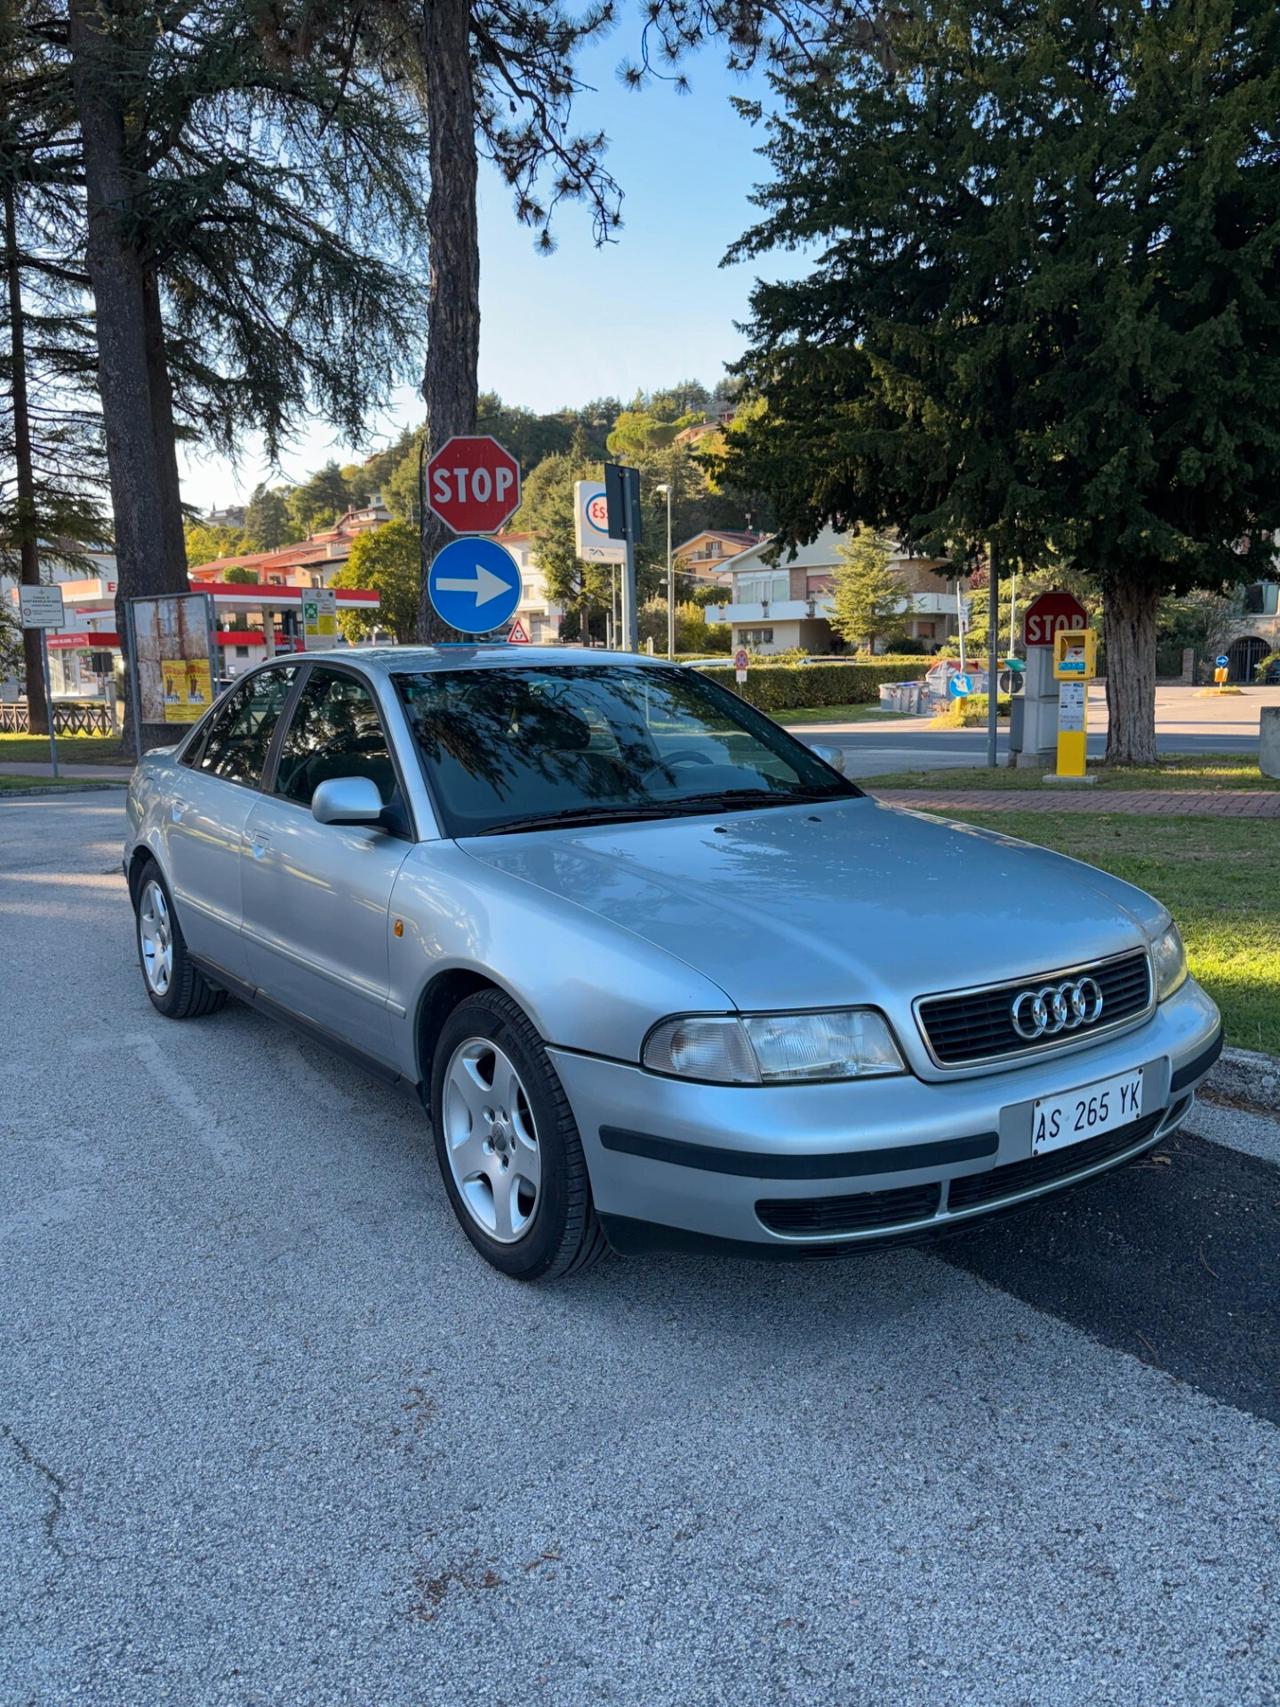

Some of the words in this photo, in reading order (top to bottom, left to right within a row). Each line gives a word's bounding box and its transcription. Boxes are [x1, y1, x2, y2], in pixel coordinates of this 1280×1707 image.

[433, 467, 513, 503] STOP
[1028, 614, 1084, 641] STOP
[1035, 1109, 1061, 1143] AS
[1074, 1091, 1110, 1131] 265
[1120, 1080, 1141, 1114] YK
